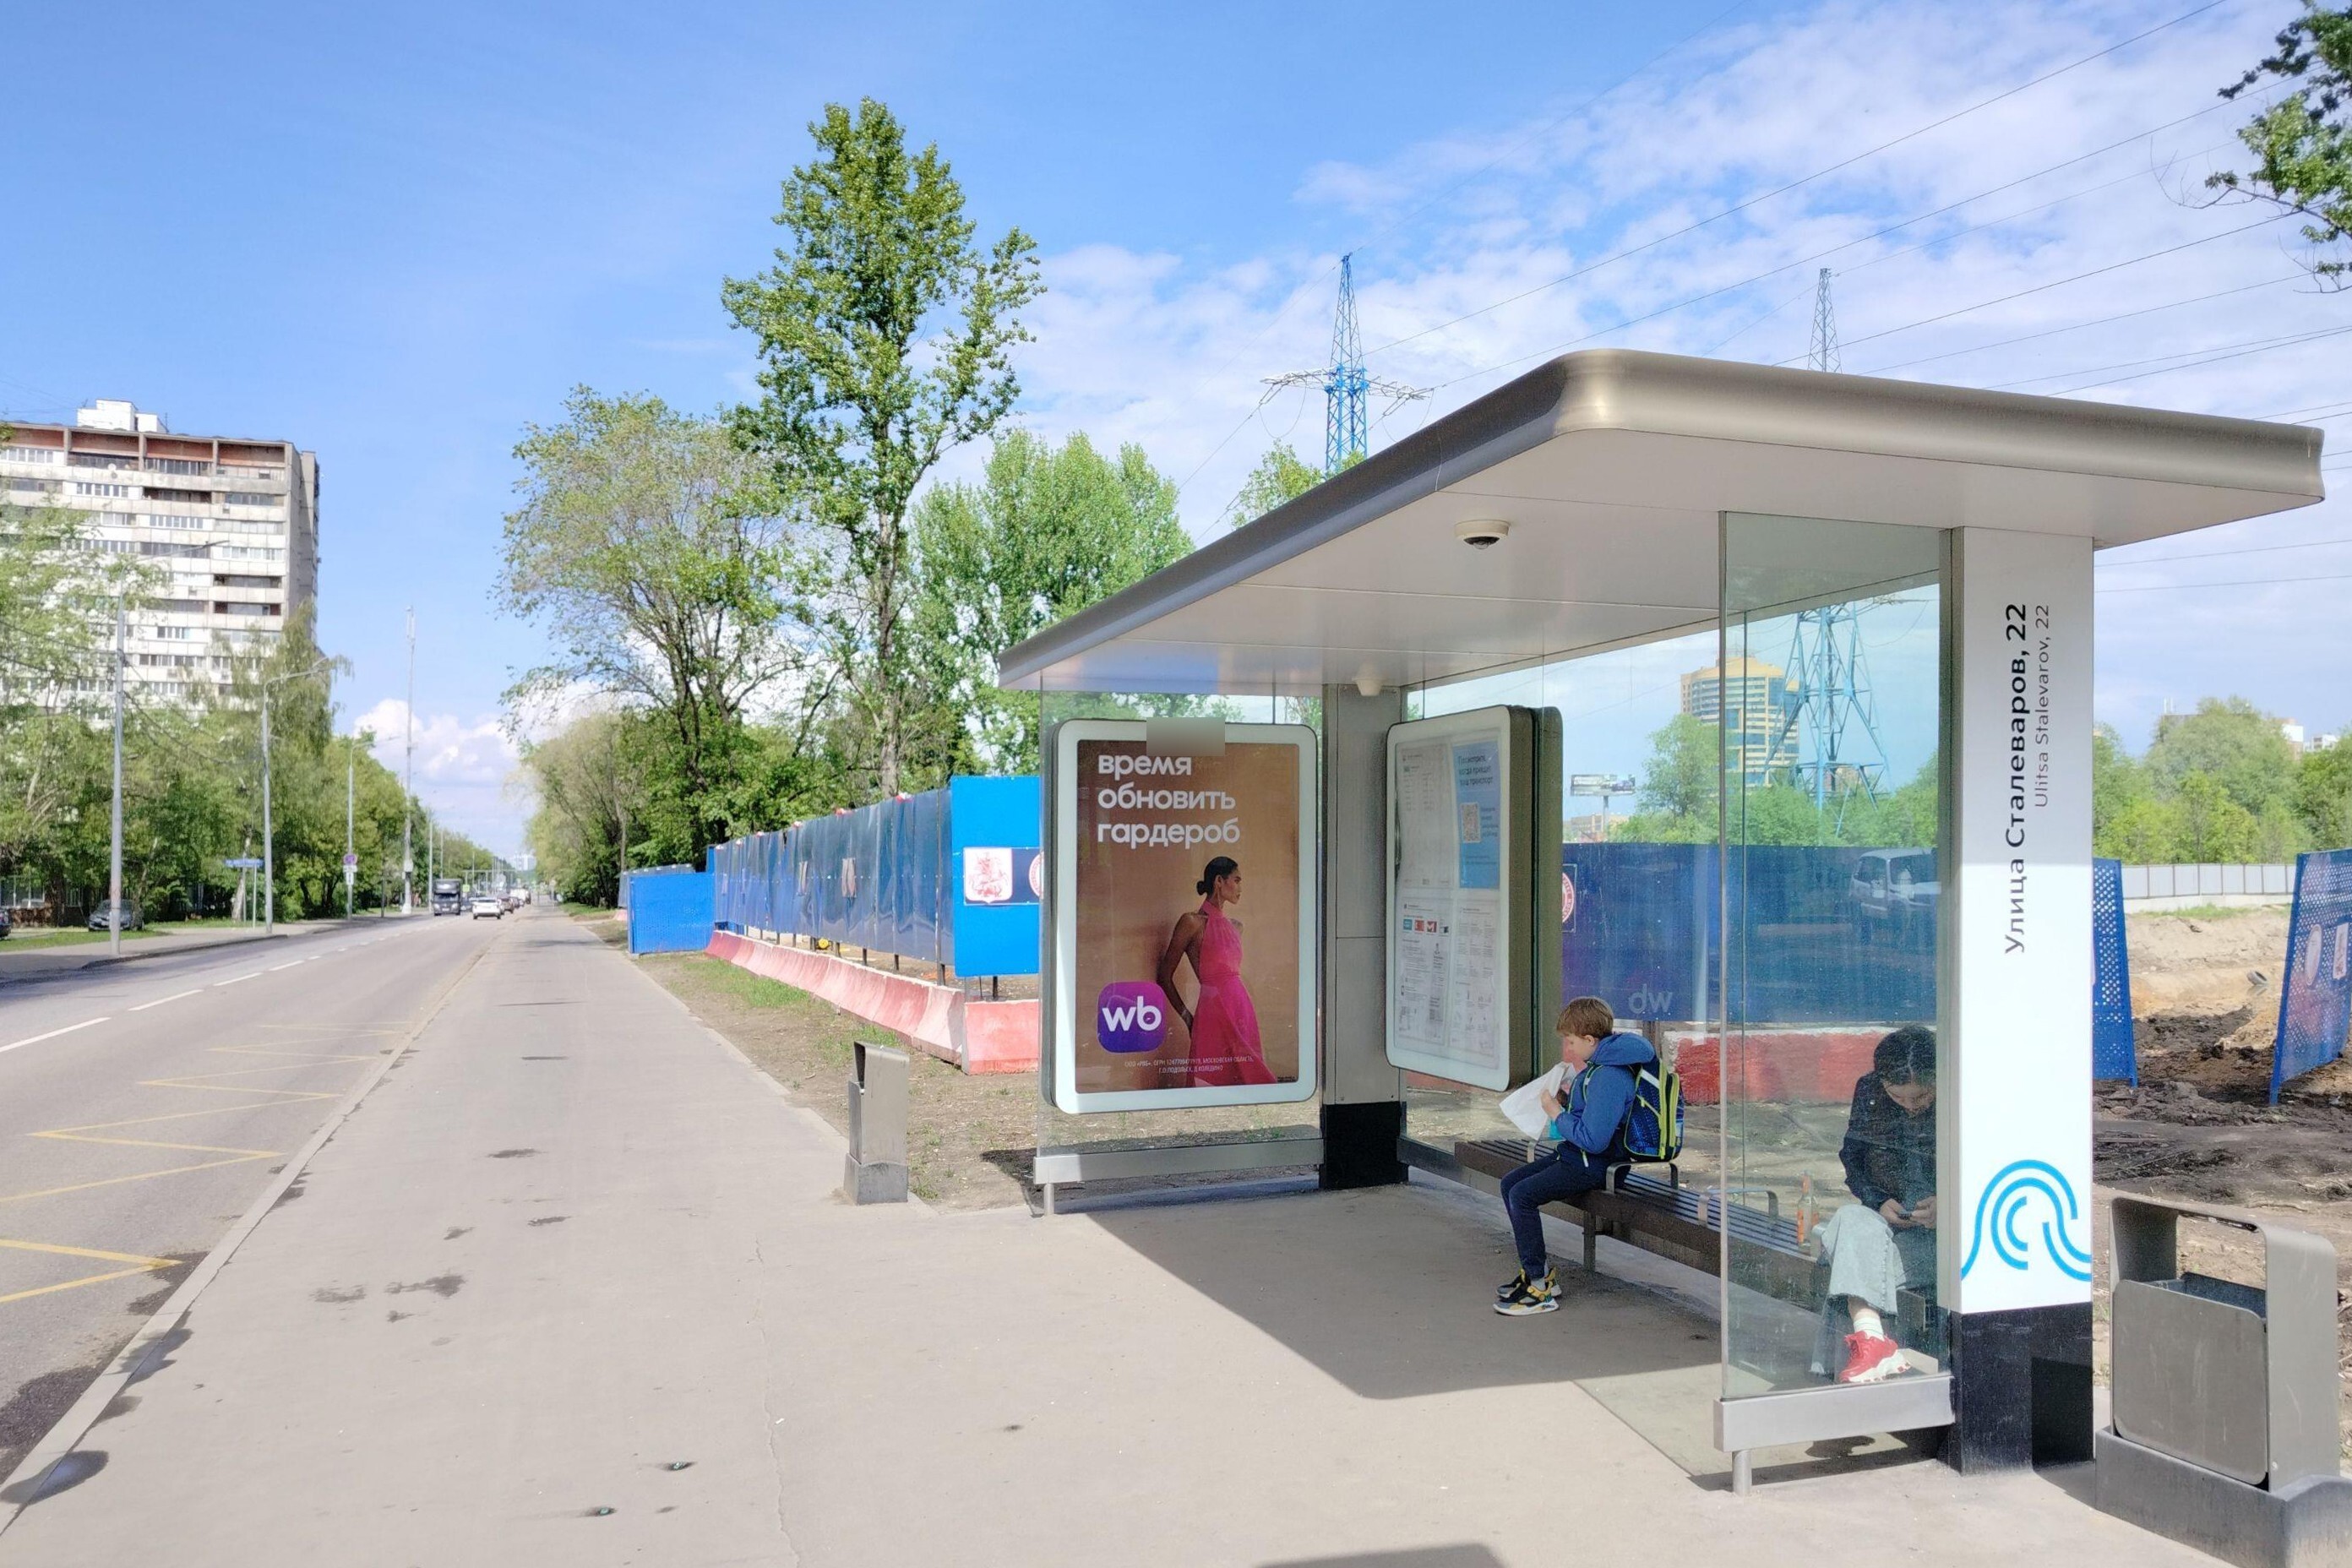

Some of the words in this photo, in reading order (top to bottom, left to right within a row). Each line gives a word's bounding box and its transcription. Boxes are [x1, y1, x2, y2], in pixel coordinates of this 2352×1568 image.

[2006, 603, 2026, 641] 22
[2035, 604, 2049, 629] 22
[2035, 636, 2051, 744] Stalevarov,
[2006, 650, 2030, 847] Сталеваров,
[1098, 754, 1192, 781] время
[2035, 751, 2049, 807] Ulitsa
[1098, 781, 1236, 810] обновить
[1098, 817, 1240, 849] гардероб
[2005, 858, 2028, 954] Улица
[1102, 995, 1162, 1032] wb
